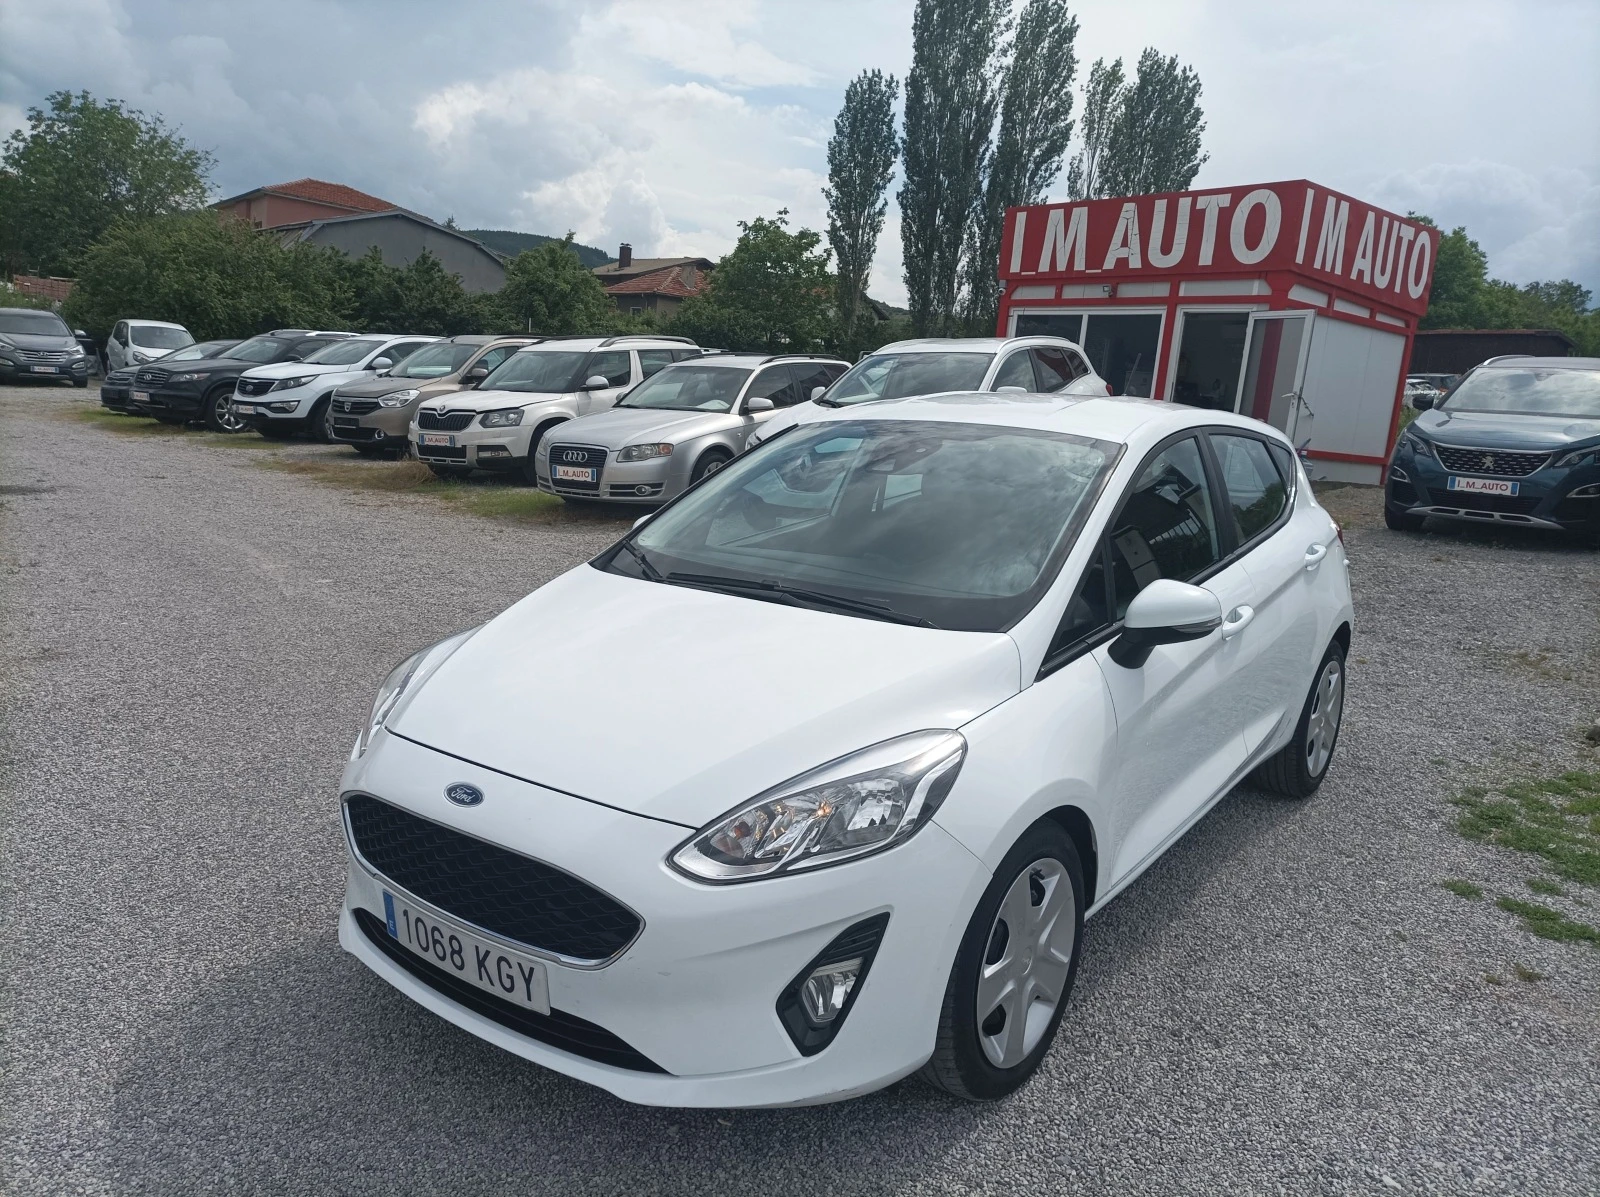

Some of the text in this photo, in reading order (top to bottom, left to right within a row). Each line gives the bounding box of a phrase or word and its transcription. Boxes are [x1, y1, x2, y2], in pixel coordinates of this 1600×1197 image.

[1295, 188, 1431, 300] I M AUTO
[451, 786, 476, 803] Ford
[402, 908, 535, 1002] 1068 KGY
